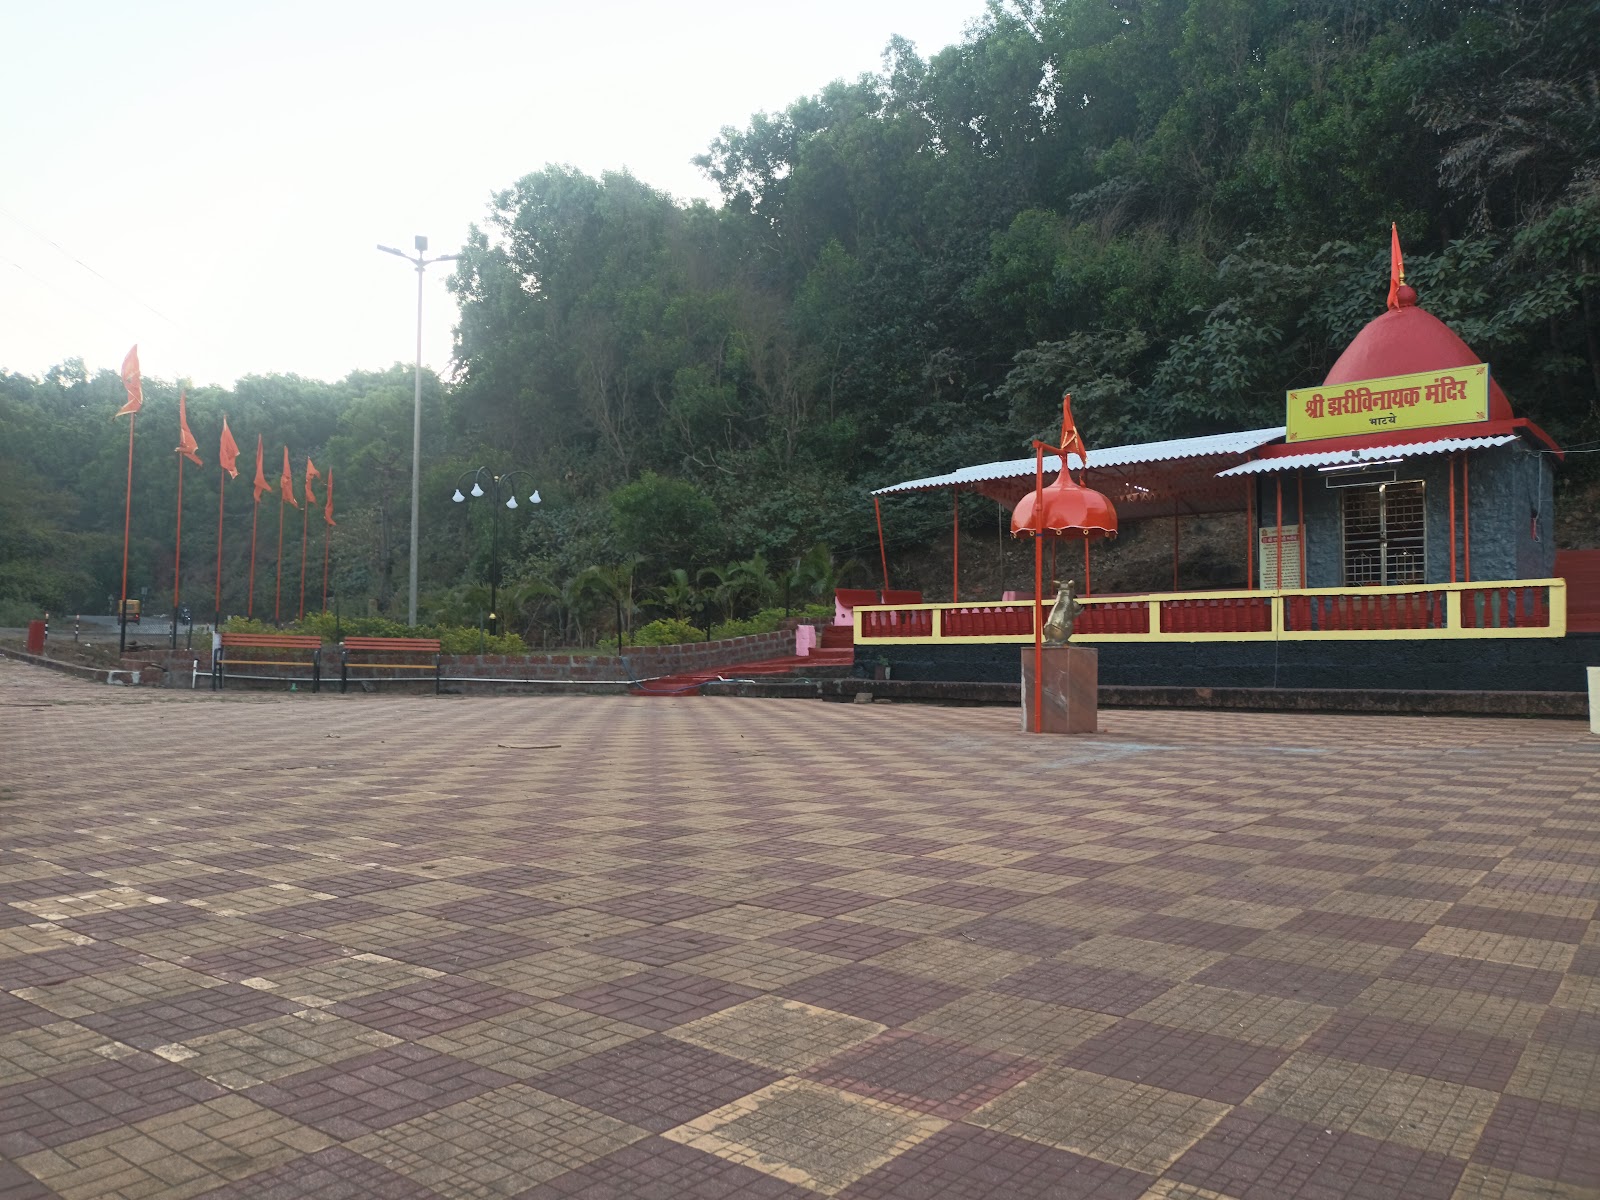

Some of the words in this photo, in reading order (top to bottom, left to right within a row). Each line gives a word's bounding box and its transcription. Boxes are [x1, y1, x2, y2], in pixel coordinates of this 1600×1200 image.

[1305, 394, 1325, 418] श्री
[1328, 386, 1421, 416] झरीविनायक
[1425, 376, 1467, 404] मंदिर
[1369, 413, 1397, 426] भाटये
